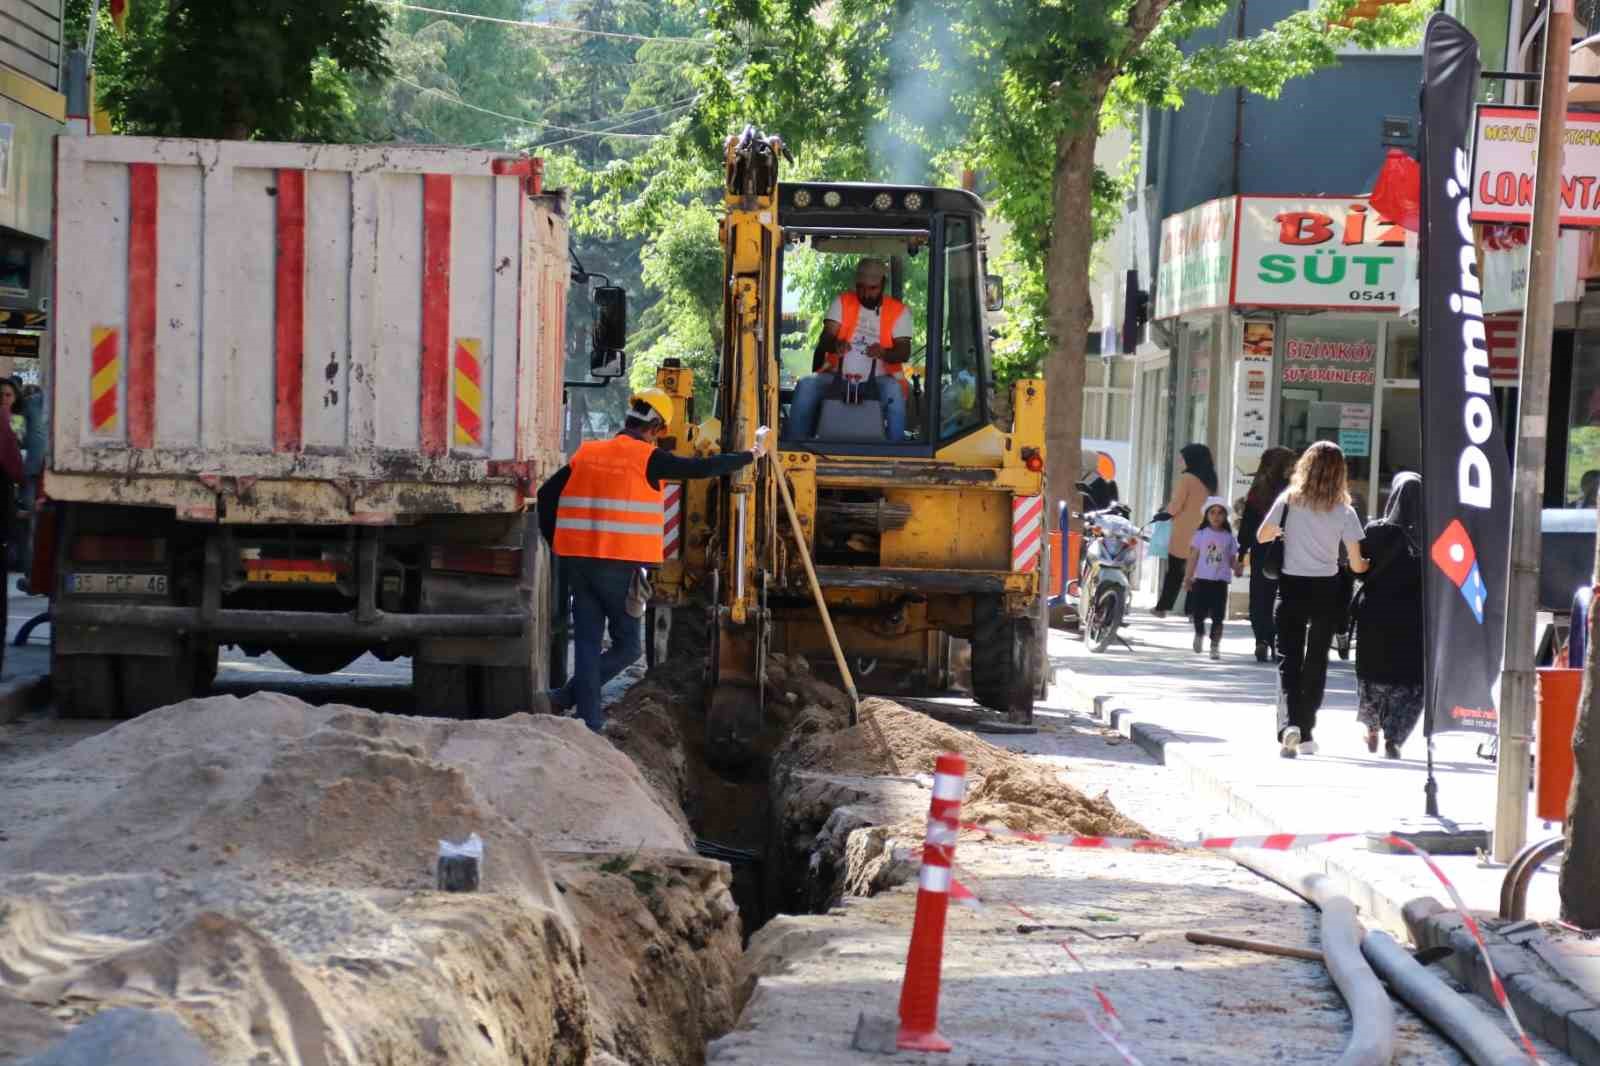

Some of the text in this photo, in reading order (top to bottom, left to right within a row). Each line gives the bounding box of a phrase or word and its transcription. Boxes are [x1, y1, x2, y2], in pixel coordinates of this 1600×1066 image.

[1258, 249, 1394, 285] SÜT
[1350, 290, 1395, 301] 0541
[148, 576, 165, 593] 46
